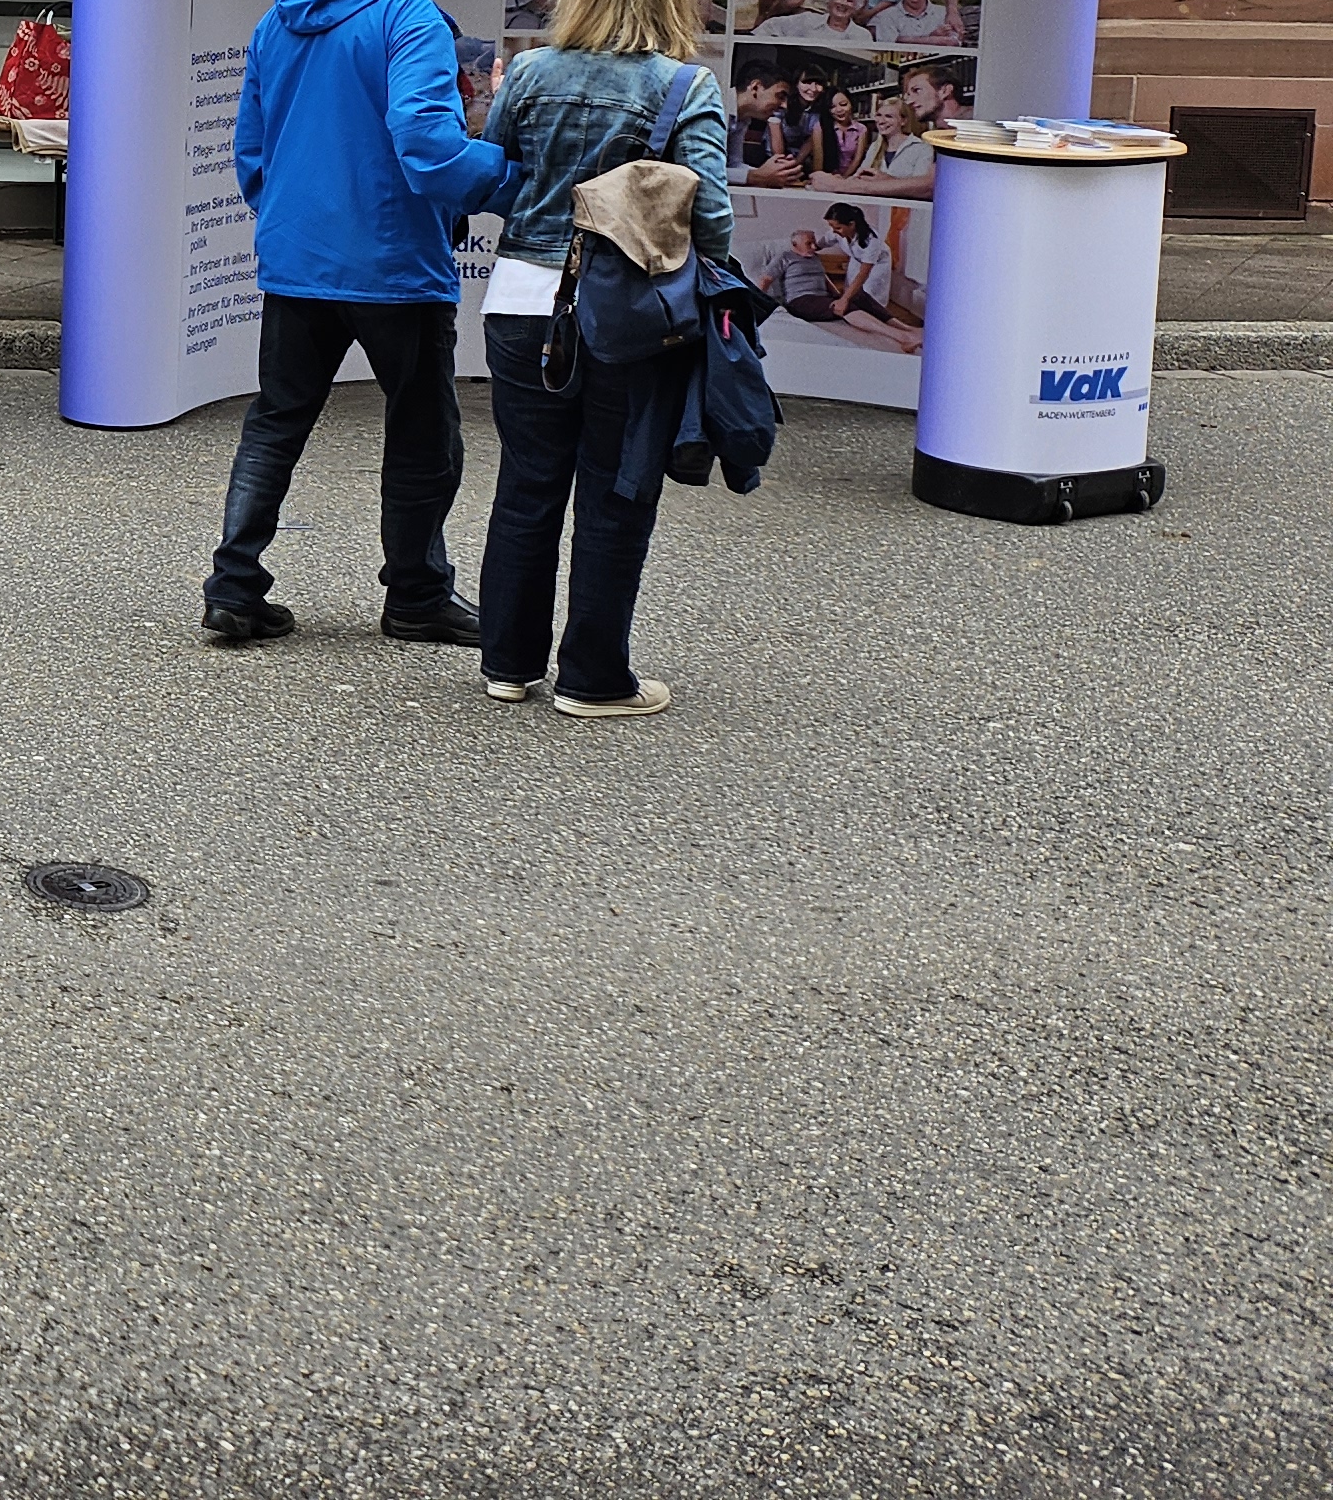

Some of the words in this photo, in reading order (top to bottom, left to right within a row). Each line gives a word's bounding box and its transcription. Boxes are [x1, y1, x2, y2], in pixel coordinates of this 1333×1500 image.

[191, 49, 226, 66] Benötigen
[227, 47, 241, 60] Sie
[185, 200, 212, 217] Wenden
[212, 196, 224, 210] Sie
[225, 192, 243, 206] sich
[210, 316, 224, 331] und
[1040, 351, 1130, 365] SOZIALVERBAND
[1038, 365, 1129, 402] VdK
